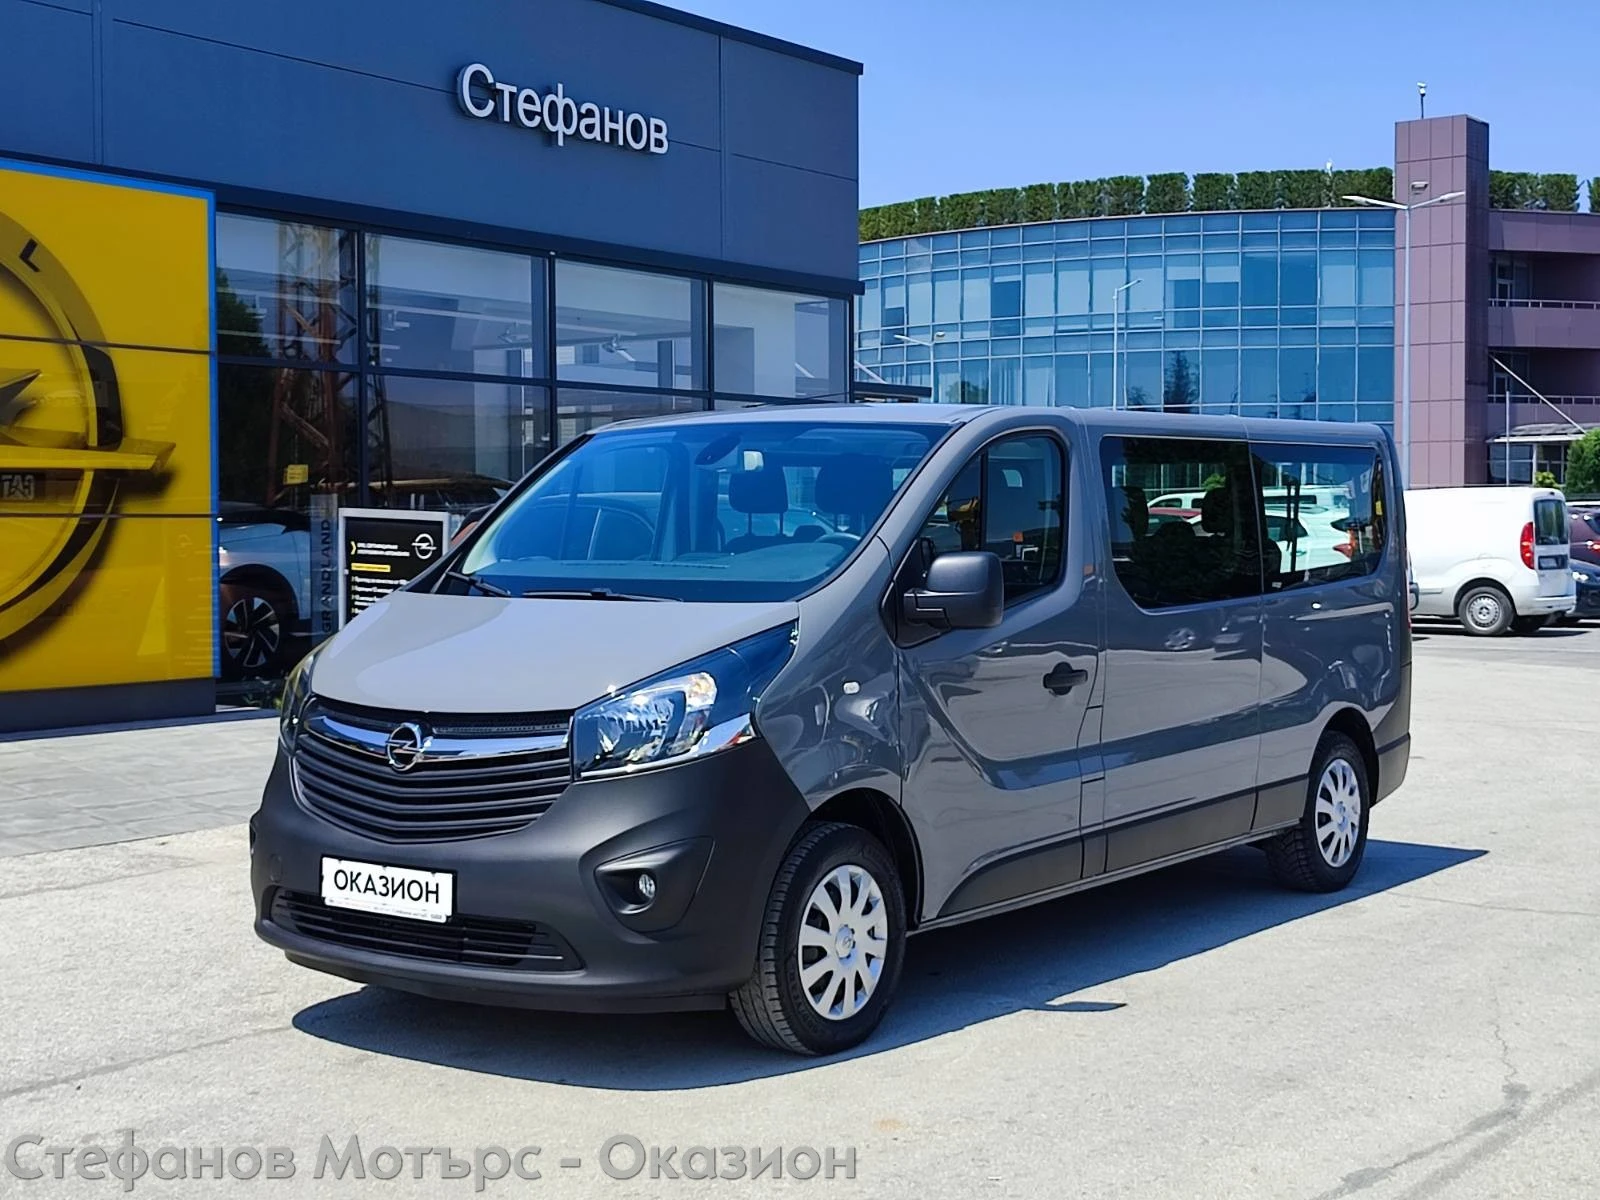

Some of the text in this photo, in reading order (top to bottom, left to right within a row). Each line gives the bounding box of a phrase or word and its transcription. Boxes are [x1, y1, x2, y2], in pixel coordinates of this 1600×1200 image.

[460, 63, 669, 154] Стефанов
[320, 519, 332, 633] GRANDLAND
[333, 869, 440, 904] ОКАЗИОН
